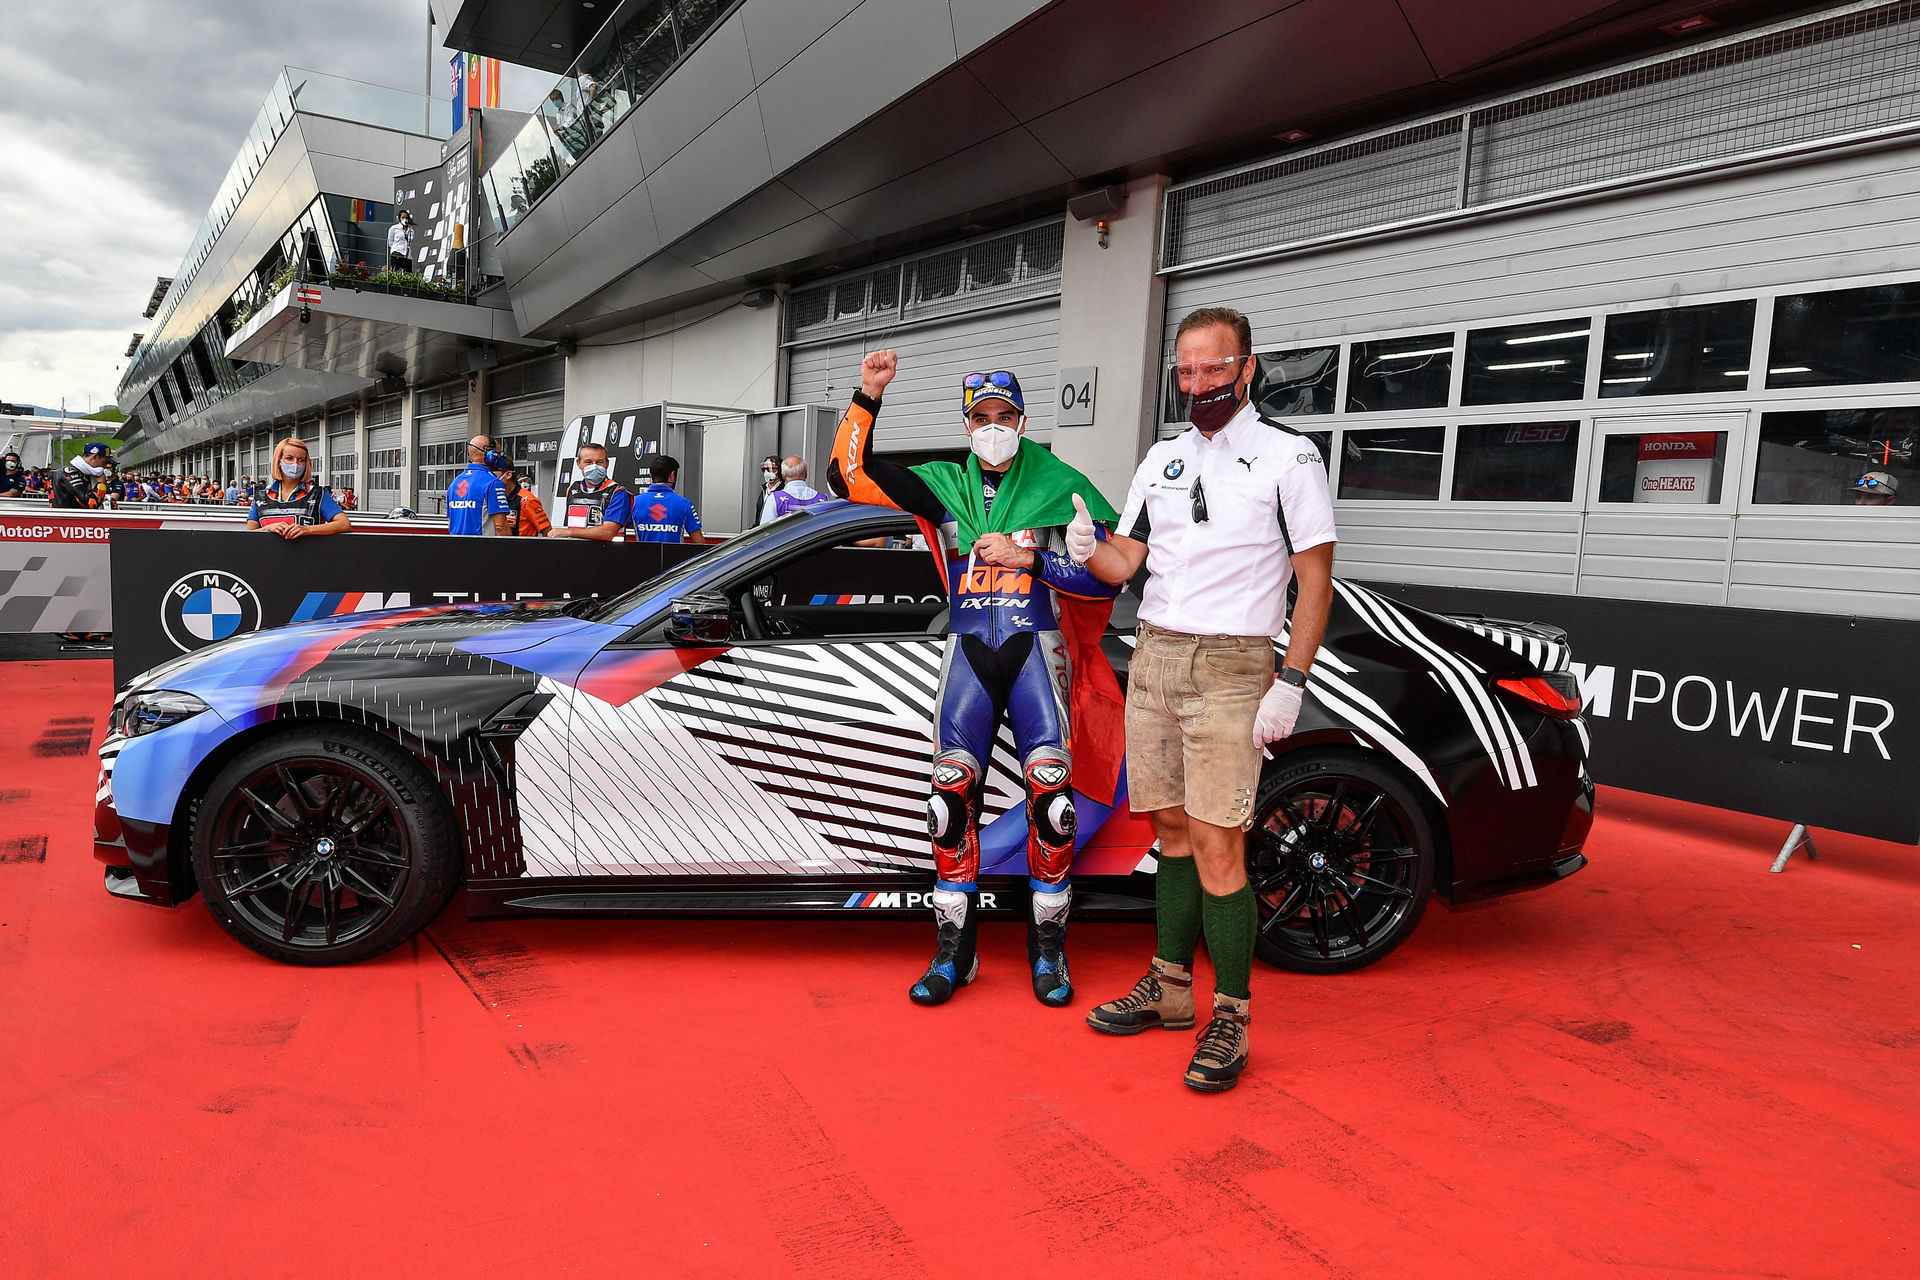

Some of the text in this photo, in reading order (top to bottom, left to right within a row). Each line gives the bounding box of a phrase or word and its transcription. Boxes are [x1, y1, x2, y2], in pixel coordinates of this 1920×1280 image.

[973, 387, 1013, 399] MICHELIN
[1061, 382, 1091, 410] 04
[1644, 442, 1697, 451] HONDA
[1642, 477, 1659, 490] One
[638, 523, 679, 532] SUZUKI
[174, 574, 249, 600] BMW
[958, 566, 1032, 594] KTM
[1626, 668, 1895, 761] POWER
[344, 747, 412, 802] MICHELIN
[906, 893, 997, 908] POR
